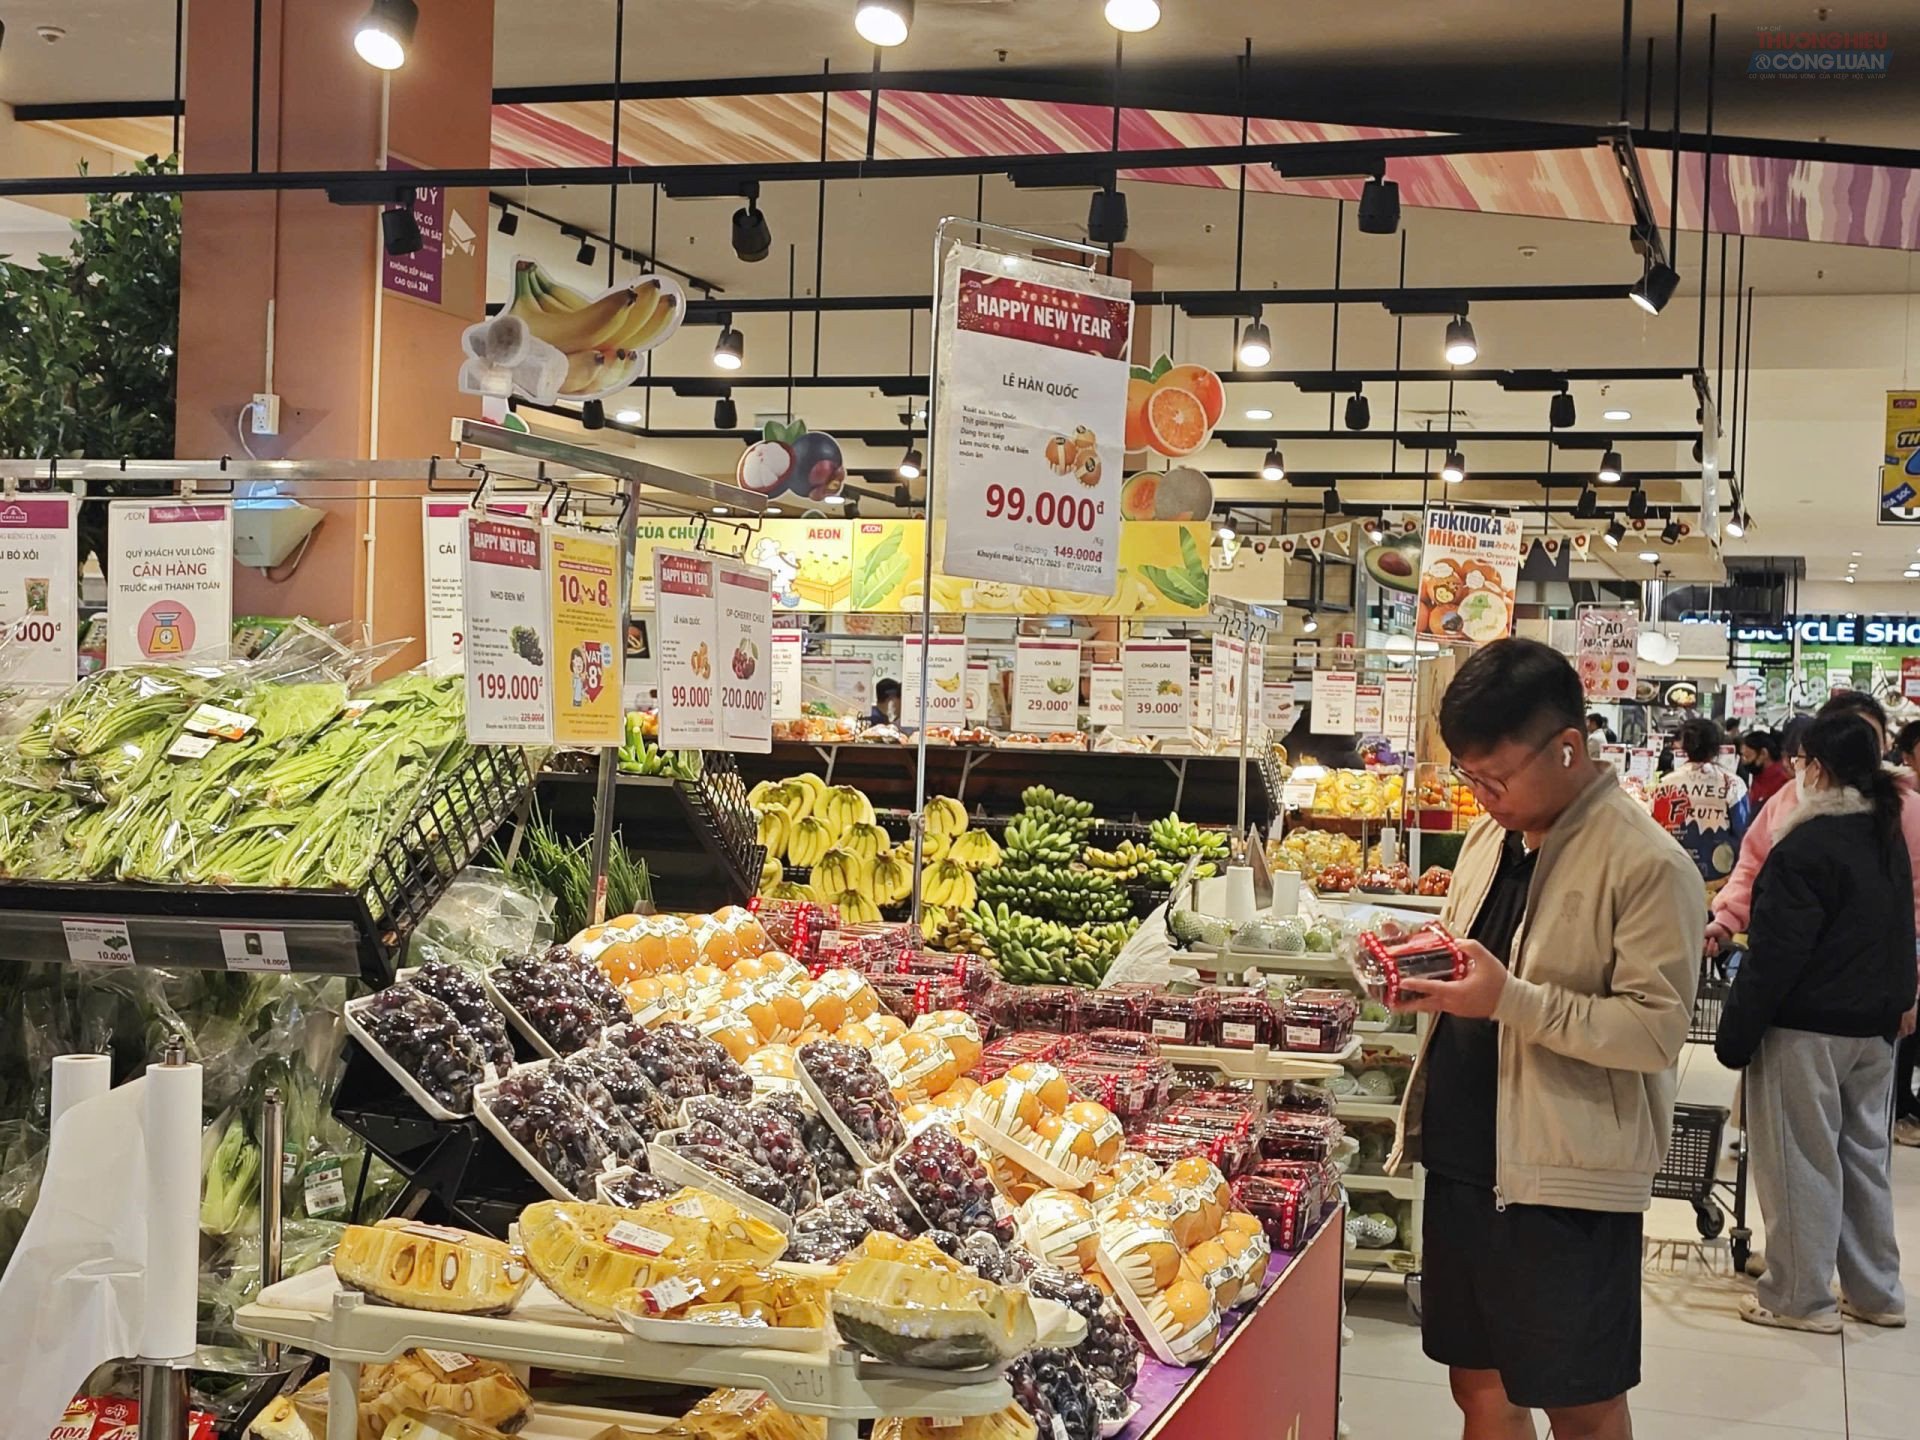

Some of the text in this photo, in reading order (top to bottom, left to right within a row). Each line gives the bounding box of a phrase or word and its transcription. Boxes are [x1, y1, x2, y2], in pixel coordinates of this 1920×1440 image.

[390, 261, 408, 274] KHÔNG
[394, 276, 405, 286] CAO
[418, 281, 428, 292] 2M
[977, 293, 1111, 339] HAPPY NEW YEAR
[1018, 376, 1044, 393] HÀN
[1046, 383, 1079, 399] QUỐC
[1430, 513, 1502, 535] FUKUOKA
[808, 529, 841, 539] AEON
[1429, 529, 1476, 549] Mikan
[144, 549, 174, 557] KHÁCH
[175, 548, 190, 556] VUI
[473, 532, 499, 550] HAPPY
[500, 536, 517, 553] NEW
[518, 538, 536, 556] YEAR
[132, 560, 207, 577] CÂN HÀNG
[662, 568, 708, 586] HAPPY NEW YEAR
[165, 583, 194, 591] THANH
[197, 581, 220, 590] TOÁN
[586, 650, 600, 663] VAT
